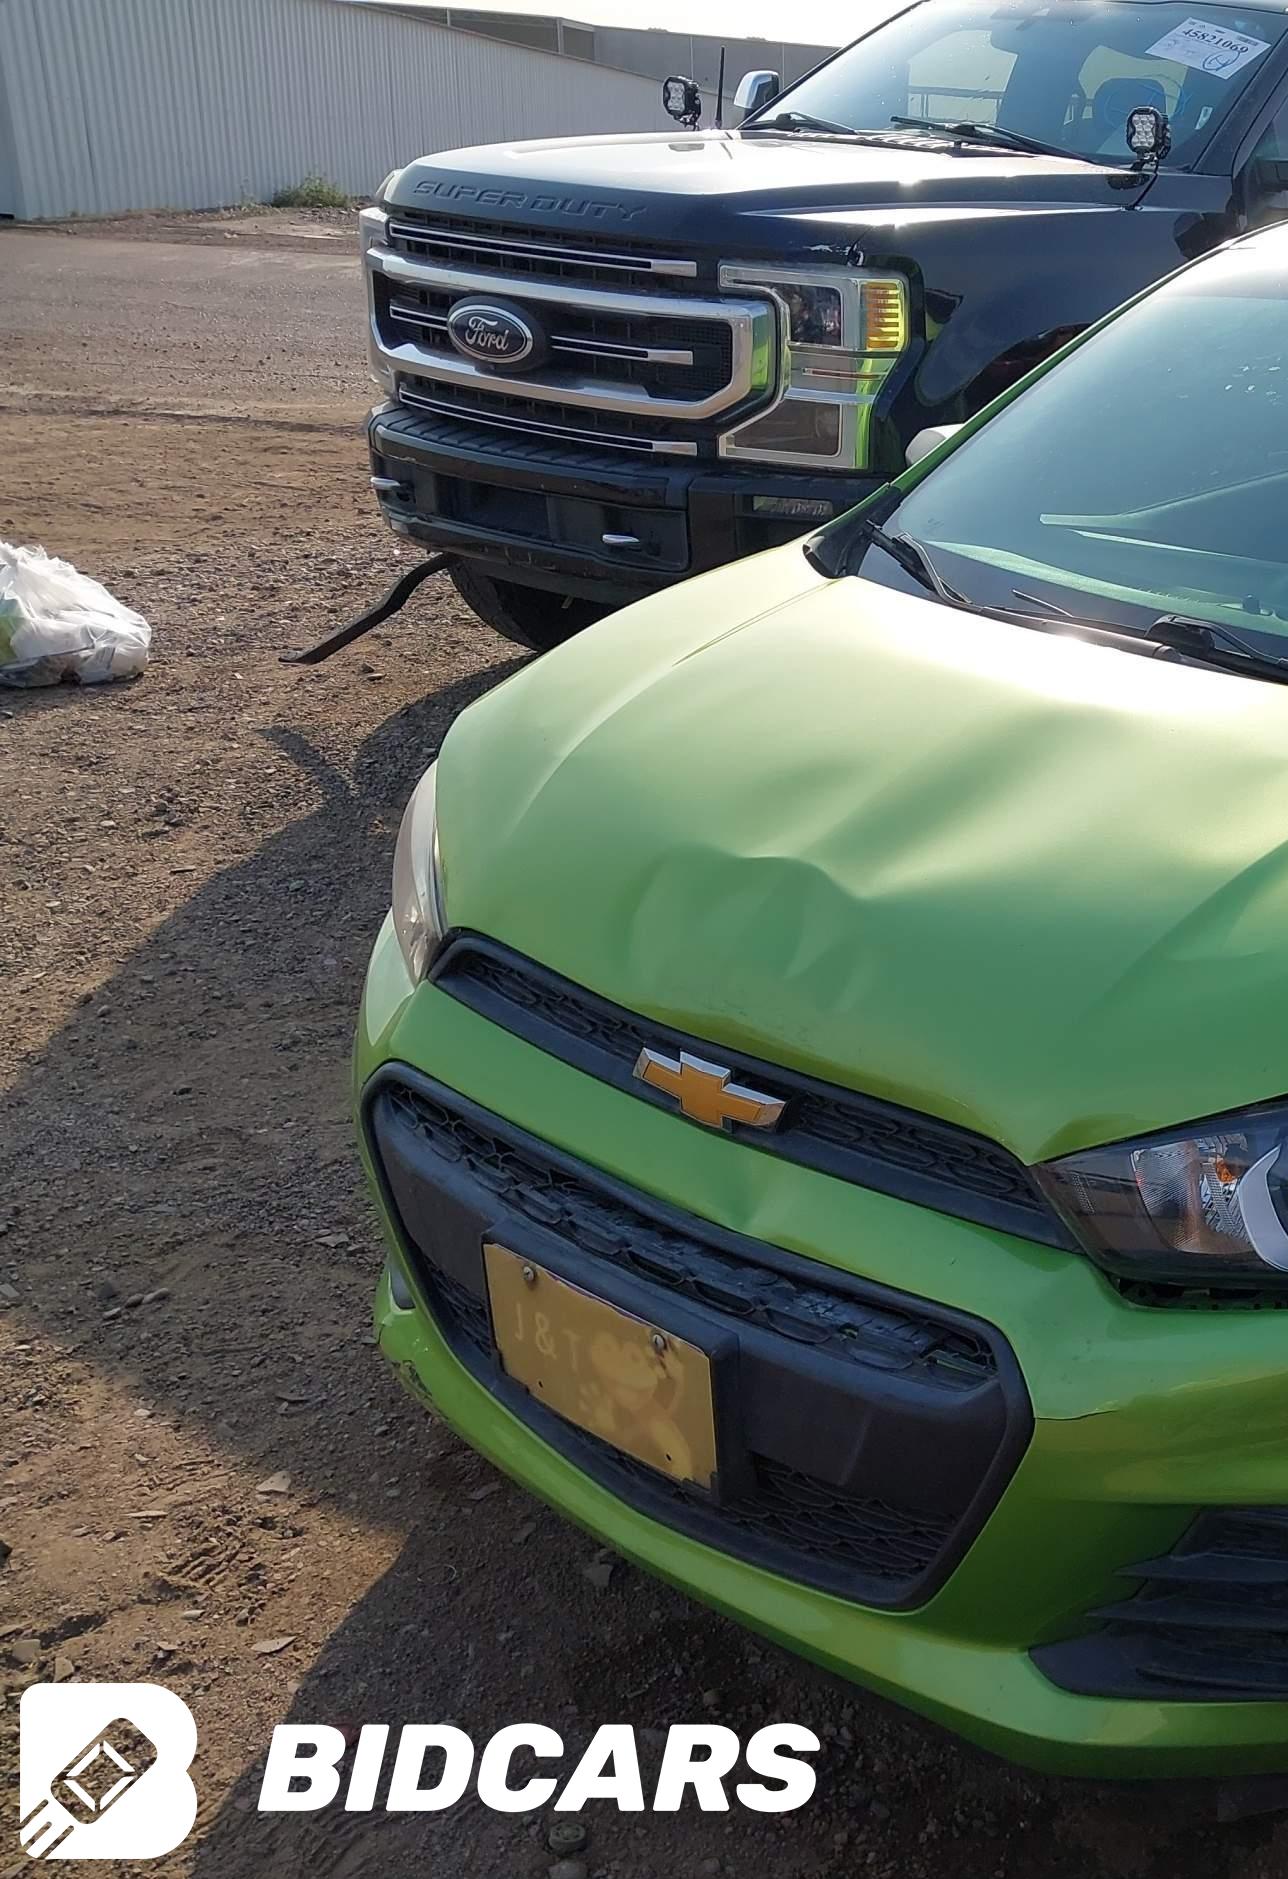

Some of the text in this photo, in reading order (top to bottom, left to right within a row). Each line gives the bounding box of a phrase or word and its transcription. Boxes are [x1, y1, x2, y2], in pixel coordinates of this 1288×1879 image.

[1182, 28, 1249, 54] 45821069
[413, 179, 647, 222] SUPER DUTY
[464, 315, 510, 351] Ford
